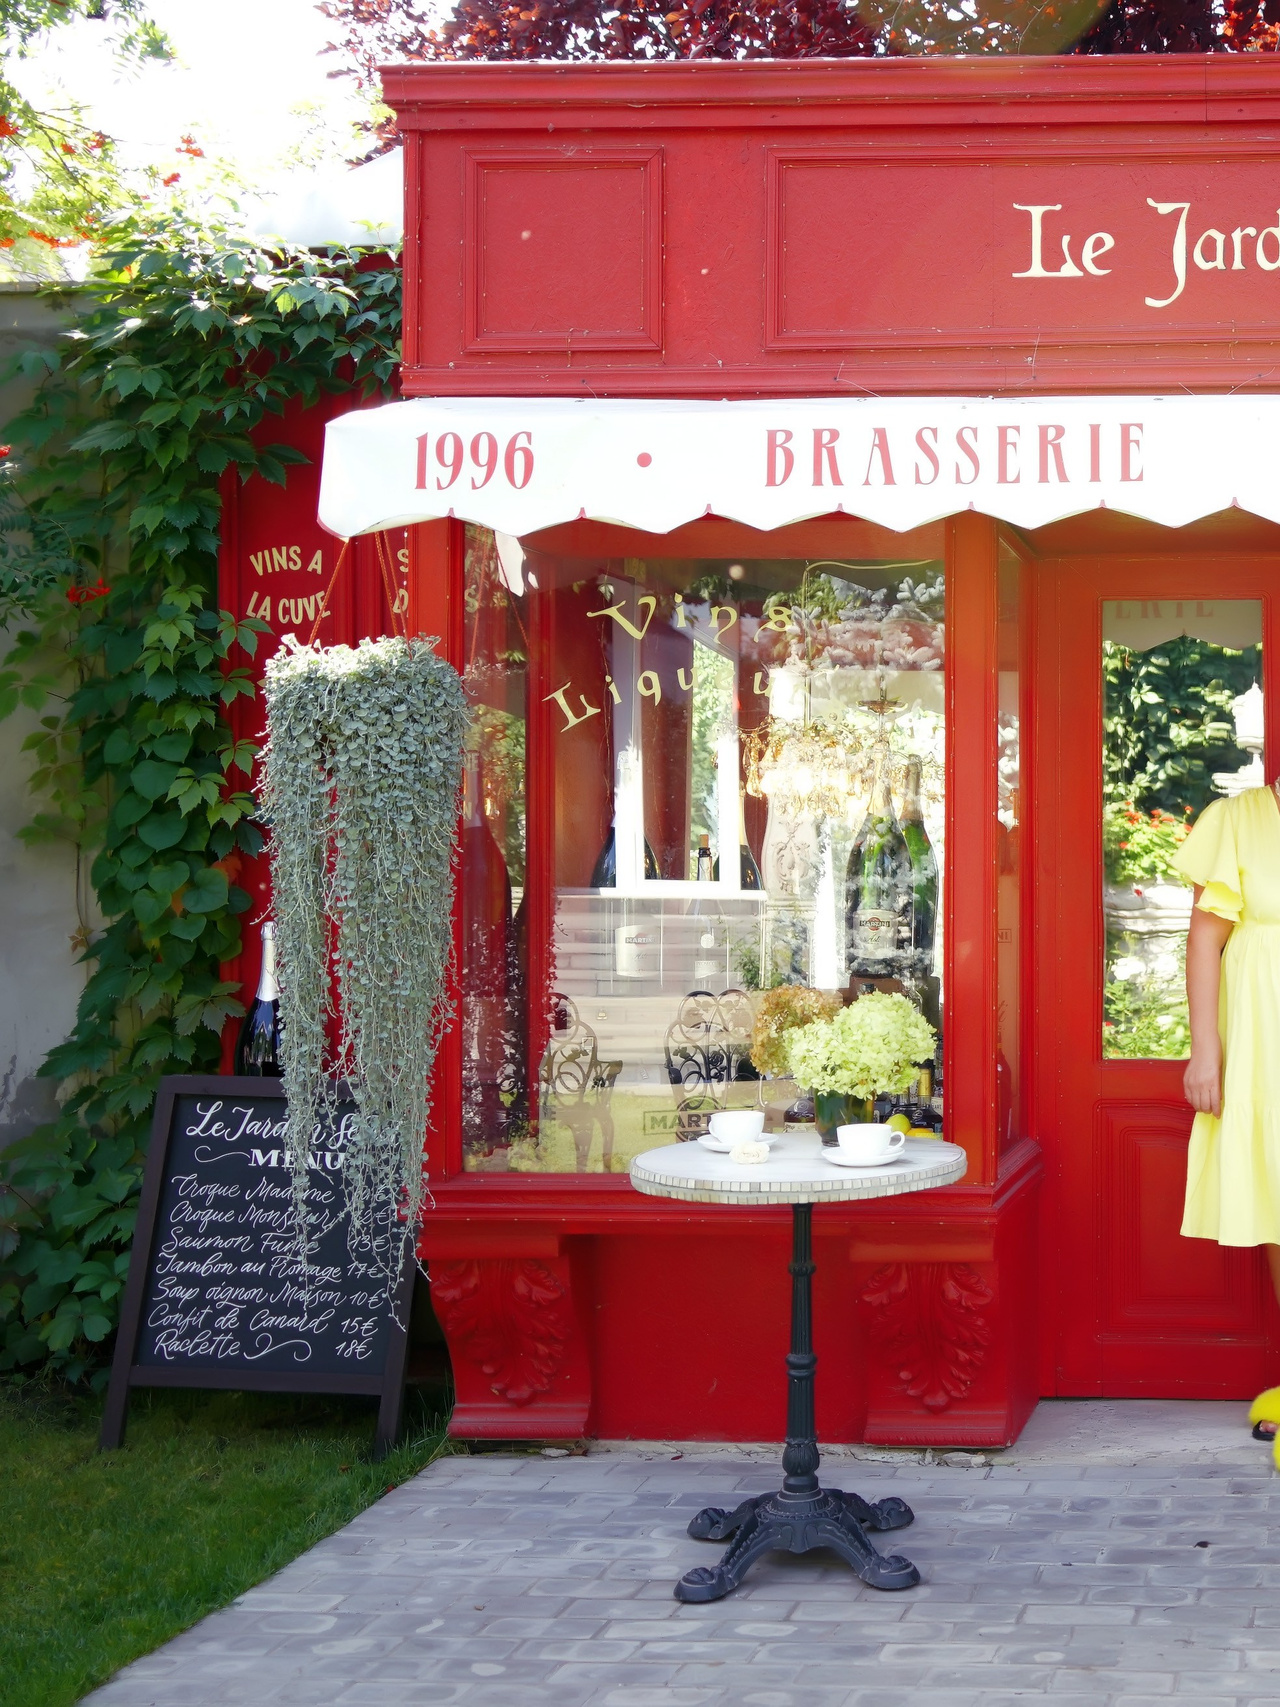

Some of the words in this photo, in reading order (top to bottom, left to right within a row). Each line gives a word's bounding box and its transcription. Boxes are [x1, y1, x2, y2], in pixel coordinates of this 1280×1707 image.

[1012, 202, 1115, 278] Le
[414, 430, 534, 490] 1996
[764, 422, 1144, 488] BRASSERIE
[249, 545, 301, 576] VINS
[307, 549, 323, 575] A
[246, 591, 271, 621] LA
[278, 590, 331, 624] CUVE
[587, 592, 794, 644] Vins
[542, 664, 775, 733] Liqueu
[186, 1101, 225, 1137] Le
[224, 1106, 327, 1145] Jardn
[650, 1113, 712, 1130] MART
[248, 1148, 347, 1170] MENU
[171, 1173, 241, 1206] Croque
[245, 1176, 335, 1204] Madme
[170, 1201, 235, 1233] Croque
[162, 1227, 254, 1252] Saumon
[156, 1252, 238, 1277] Jambon
[241, 1260, 264, 1275] au
[152, 1277, 200, 1309] Soup
[206, 1281, 268, 1309] oignon
[270, 1280, 347, 1307] Maison
[148, 1303, 213, 1335] Confit
[214, 1308, 240, 1329] de
[249, 1308, 335, 1334] Canard
[341, 1316, 378, 1336] 15€
[154, 1328, 241, 1360] Raclette
[335, 1338, 373, 1359] 18€
